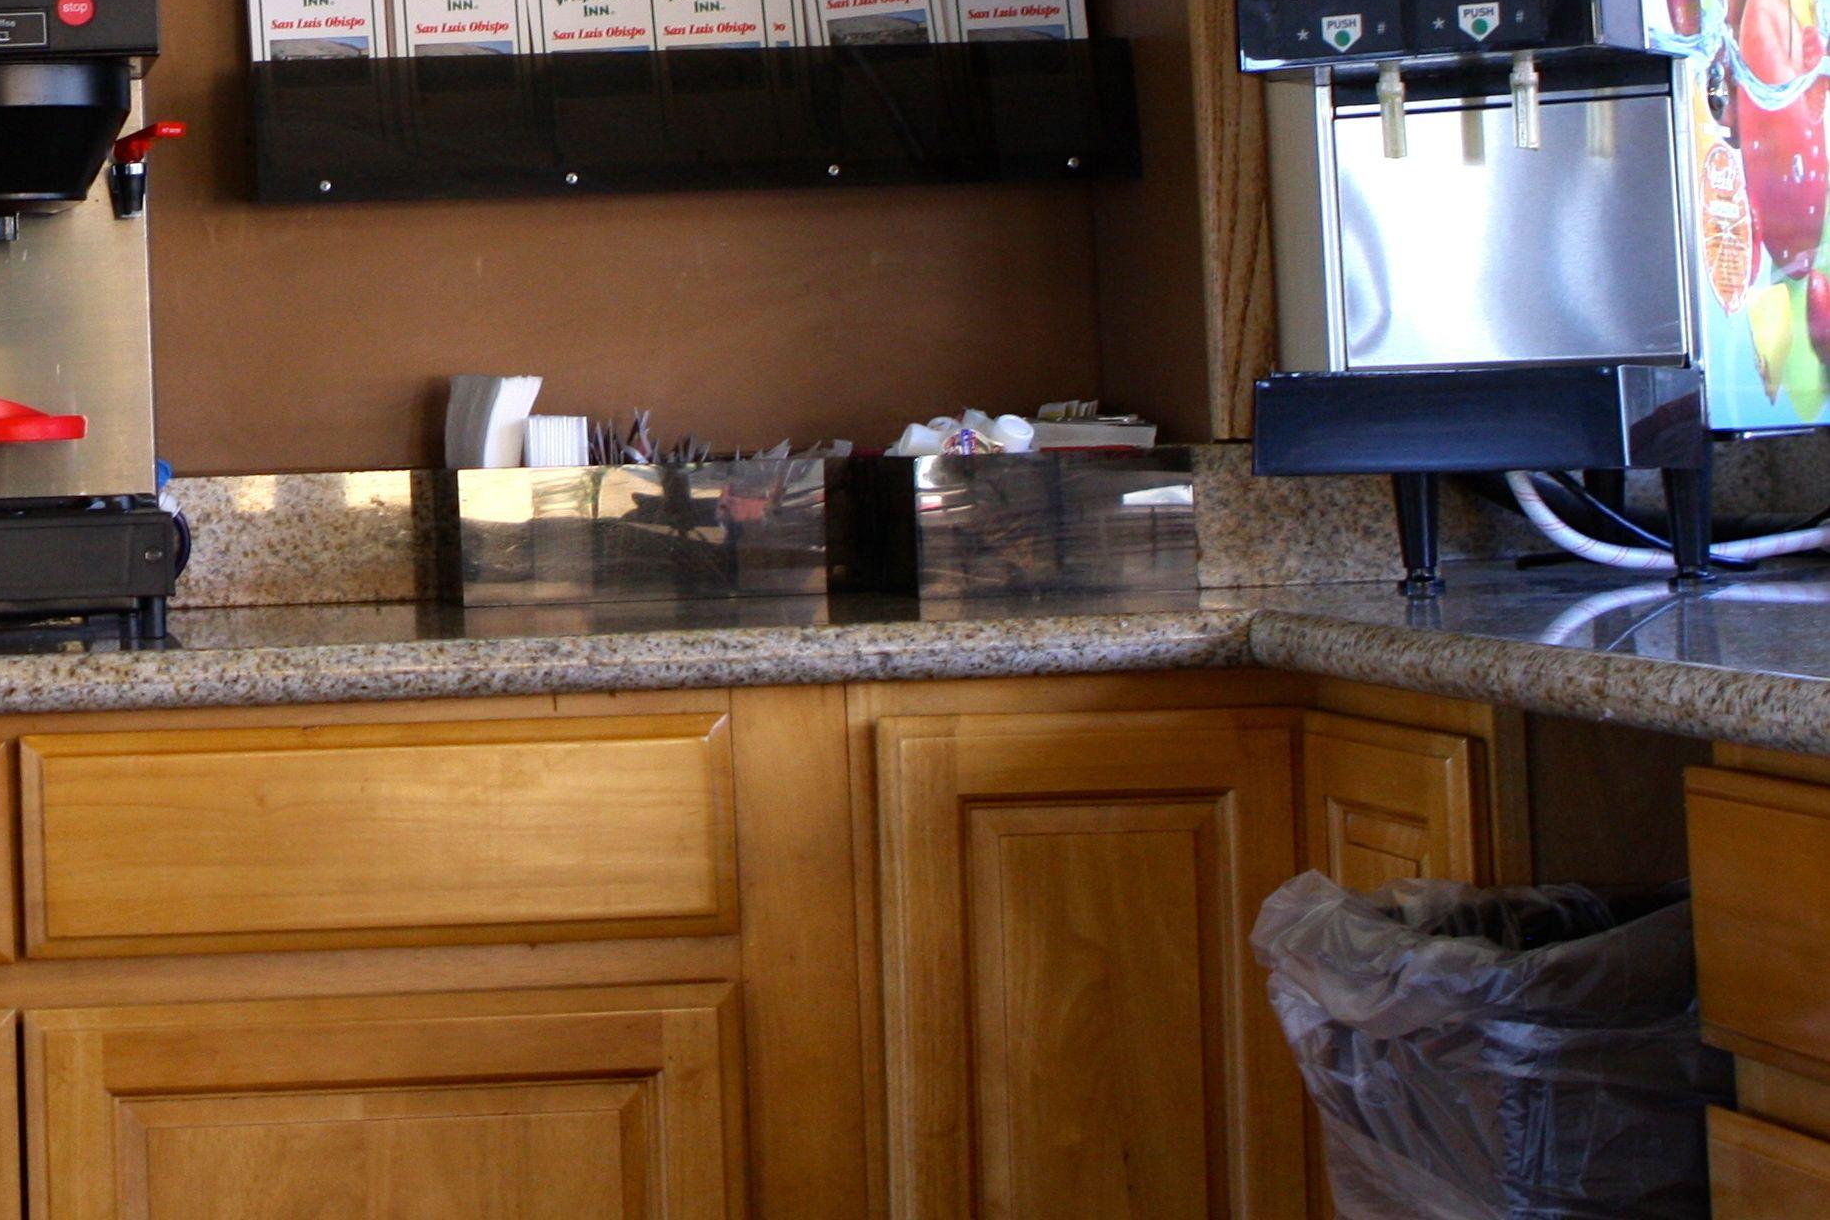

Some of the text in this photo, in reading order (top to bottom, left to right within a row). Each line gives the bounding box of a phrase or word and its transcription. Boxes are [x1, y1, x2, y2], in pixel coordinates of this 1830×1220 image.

[62, 2, 88, 14] stop
[1463, 7, 1495, 18] PUSH
[271, 16, 365, 30] San Luis Obispo
[415, 21, 509, 34] San Luis Obispo
[1326, 18, 1357, 29] PUSH
